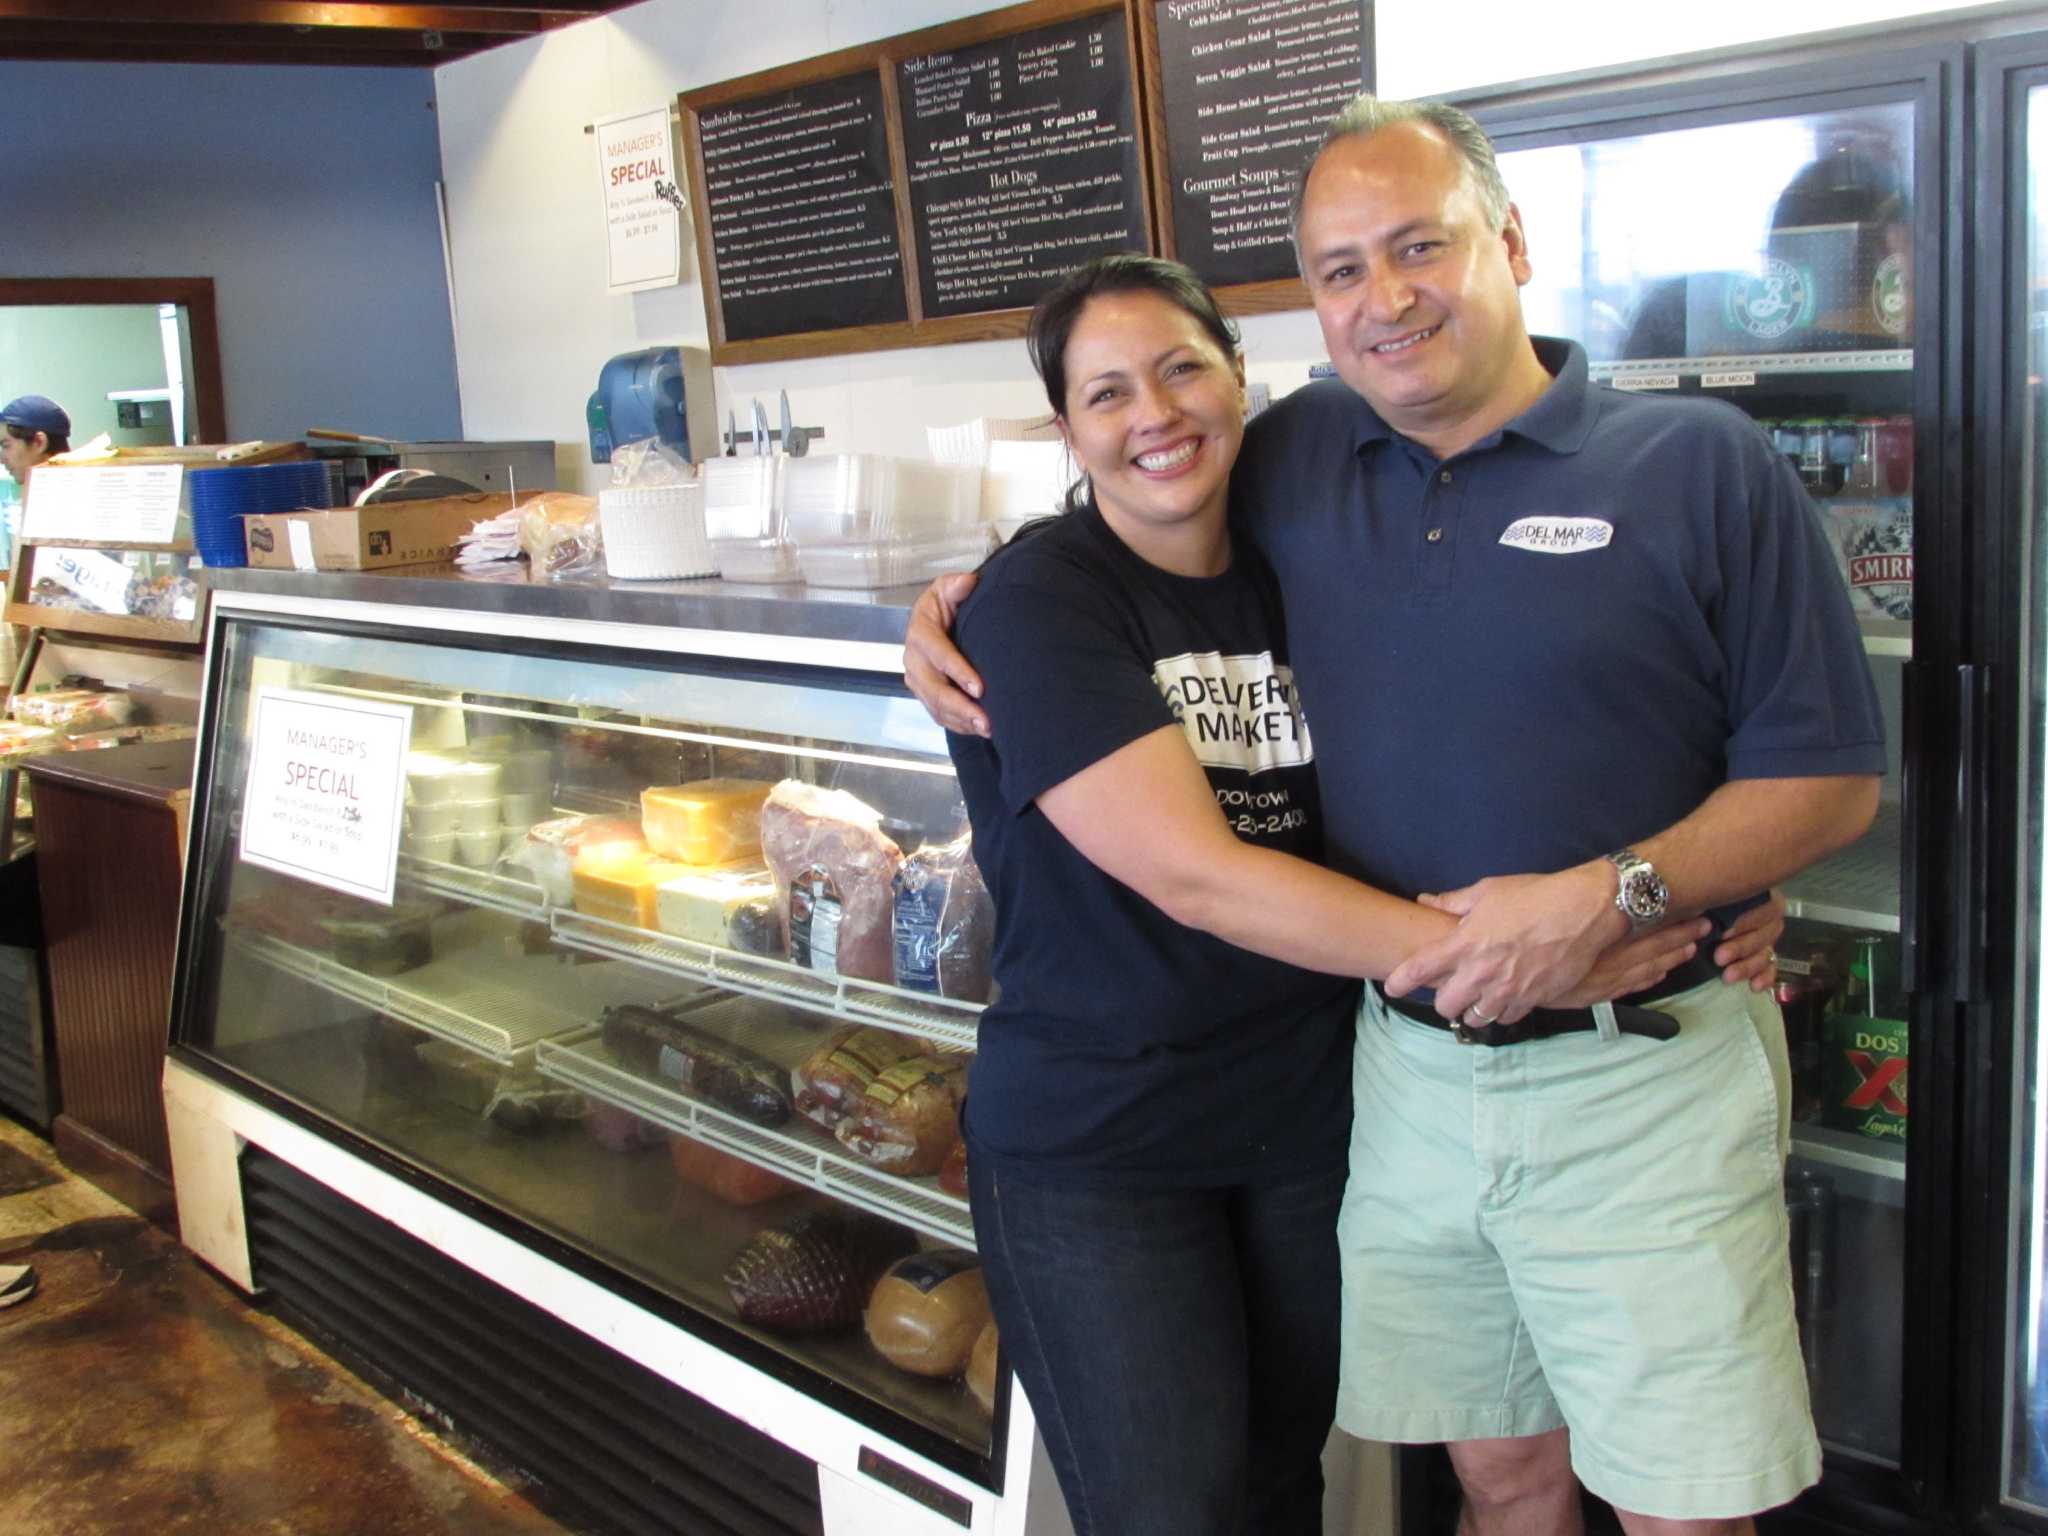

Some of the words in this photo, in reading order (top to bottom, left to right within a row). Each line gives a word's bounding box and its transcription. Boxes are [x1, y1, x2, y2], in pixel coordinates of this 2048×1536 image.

[1189, 13, 1208, 27] Cobb
[1209, 8, 1231, 23] Salad
[1191, 40, 1222, 56] Chicken
[1247, 29, 1270, 43] Salad
[903, 57, 925, 75] Side
[927, 49, 952, 68] Items
[1195, 71, 1217, 85] Seven
[1219, 64, 1246, 80] Veggie
[1247, 58, 1270, 73] Salad
[1238, 94, 1260, 108] Salad
[700, 107, 743, 131] Sandwiches
[965, 107, 991, 127] Pizza
[938, 138, 954, 151] pizza
[994, 126, 1011, 140] pizza
[1056, 113, 1075, 128] pizza
[1201, 133, 1216, 145] Side
[1239, 125, 1260, 137] Salad
[607, 131, 663, 159] MANAGER'S
[1202, 149, 1222, 161] Fruit
[1223, 146, 1238, 159] Cup
[611, 157, 665, 187] SPECIAL
[989, 170, 1008, 188] Hot
[1011, 164, 1037, 189] Dogs
[1182, 170, 1235, 194] Gourmet
[1239, 162, 1280, 189] Soups
[655, 179, 685, 212] Ruffles
[965, 196, 976, 208] Hot
[1229, 205, 1246, 216] Head
[1248, 202, 1262, 213] Beef
[943, 225, 958, 237] York
[974, 222, 985, 232] Hot
[1211, 225, 1229, 238] Soup
[1236, 220, 1252, 231] Half
[1259, 214, 1287, 228] Chicken
[968, 249, 980, 259] Hot
[1213, 241, 1230, 255] Soup
[954, 277, 965, 288] Hot
[1644, 377, 1676, 387] NEVADA
[1705, 375, 1726, 385] BLUE
[1728, 374, 1753, 384] MOON
[1525, 525, 1551, 539] DEL
[1554, 526, 1584, 540] MAR
[287, 728, 368, 760] MANAGER'S
[285, 761, 359, 801] SPECIAL
[1856, 1032, 1899, 1053] DOS
